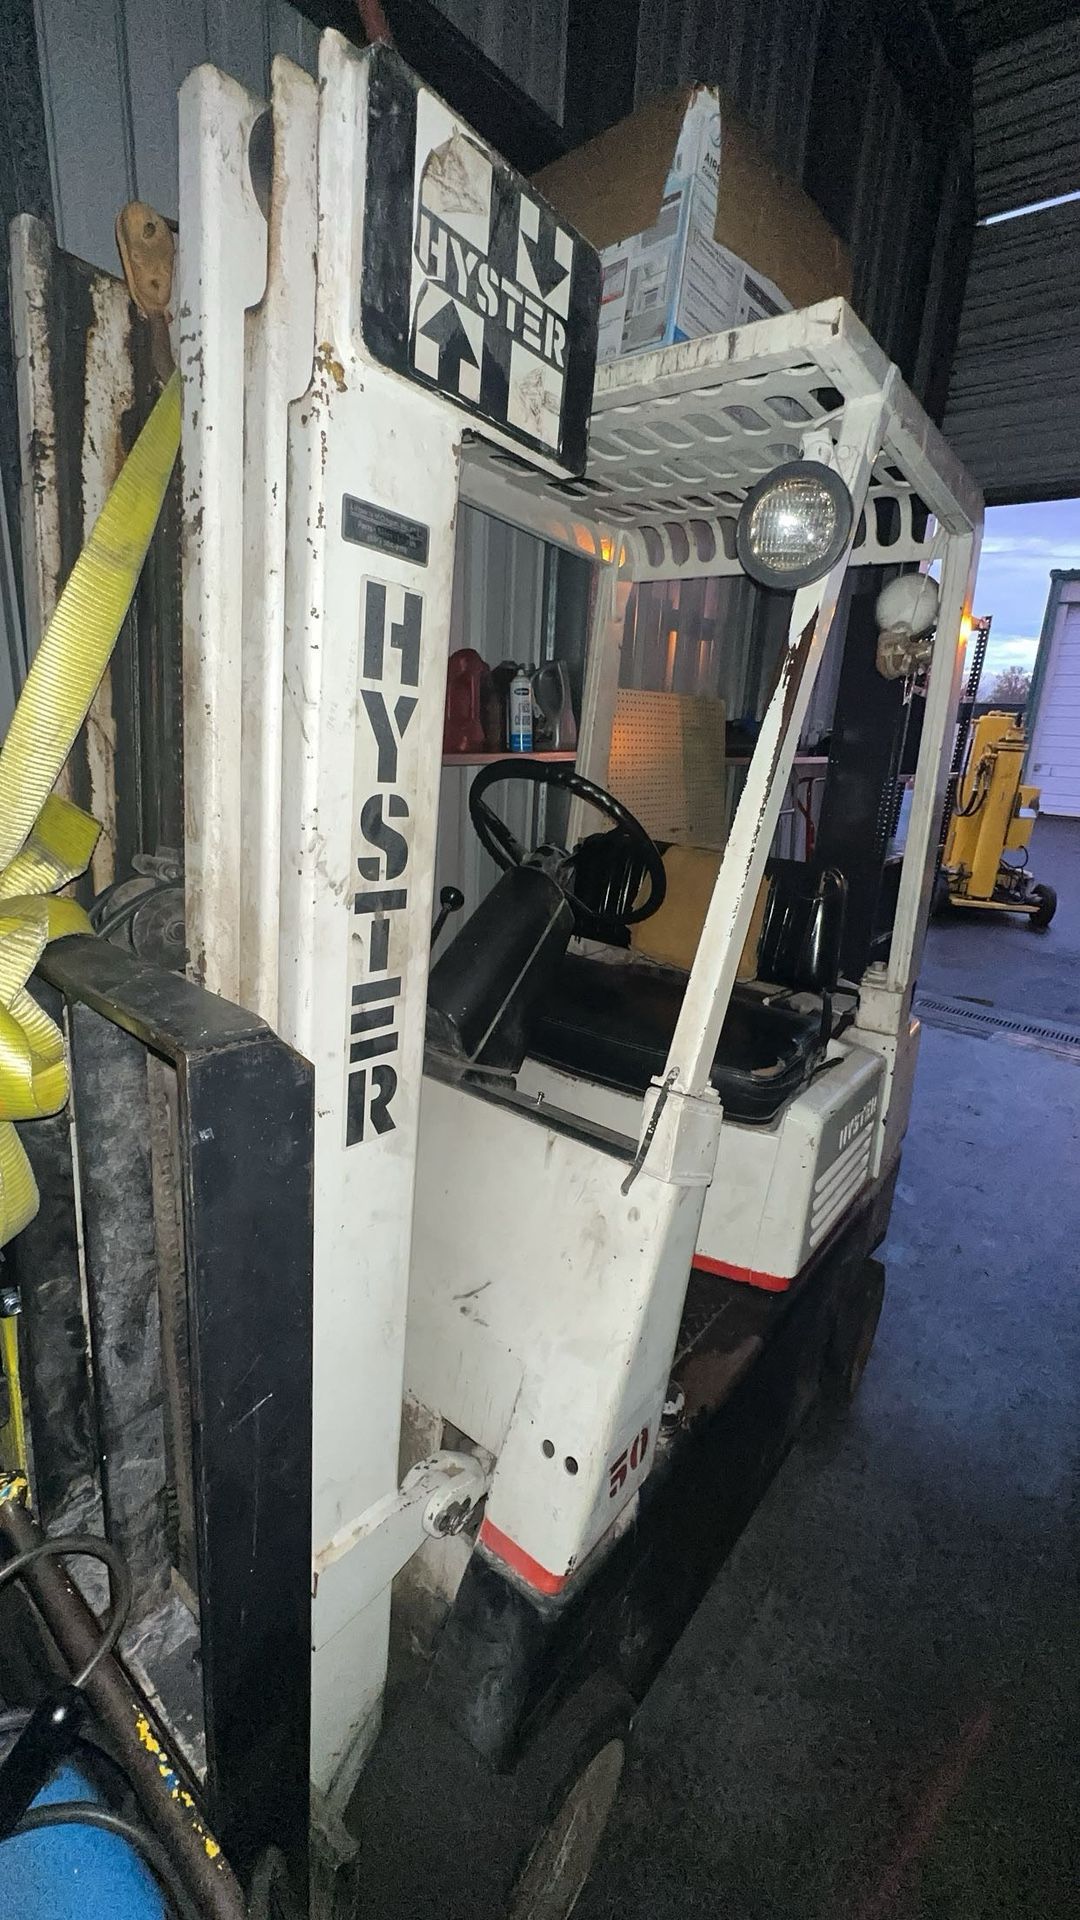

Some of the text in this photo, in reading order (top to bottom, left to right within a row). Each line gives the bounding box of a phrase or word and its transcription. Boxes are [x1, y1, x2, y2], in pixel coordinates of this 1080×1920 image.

[418, 213, 567, 369] HYSTER
[346, 580, 424, 1148] HYSTER
[609, 1427, 649, 1498] 50
